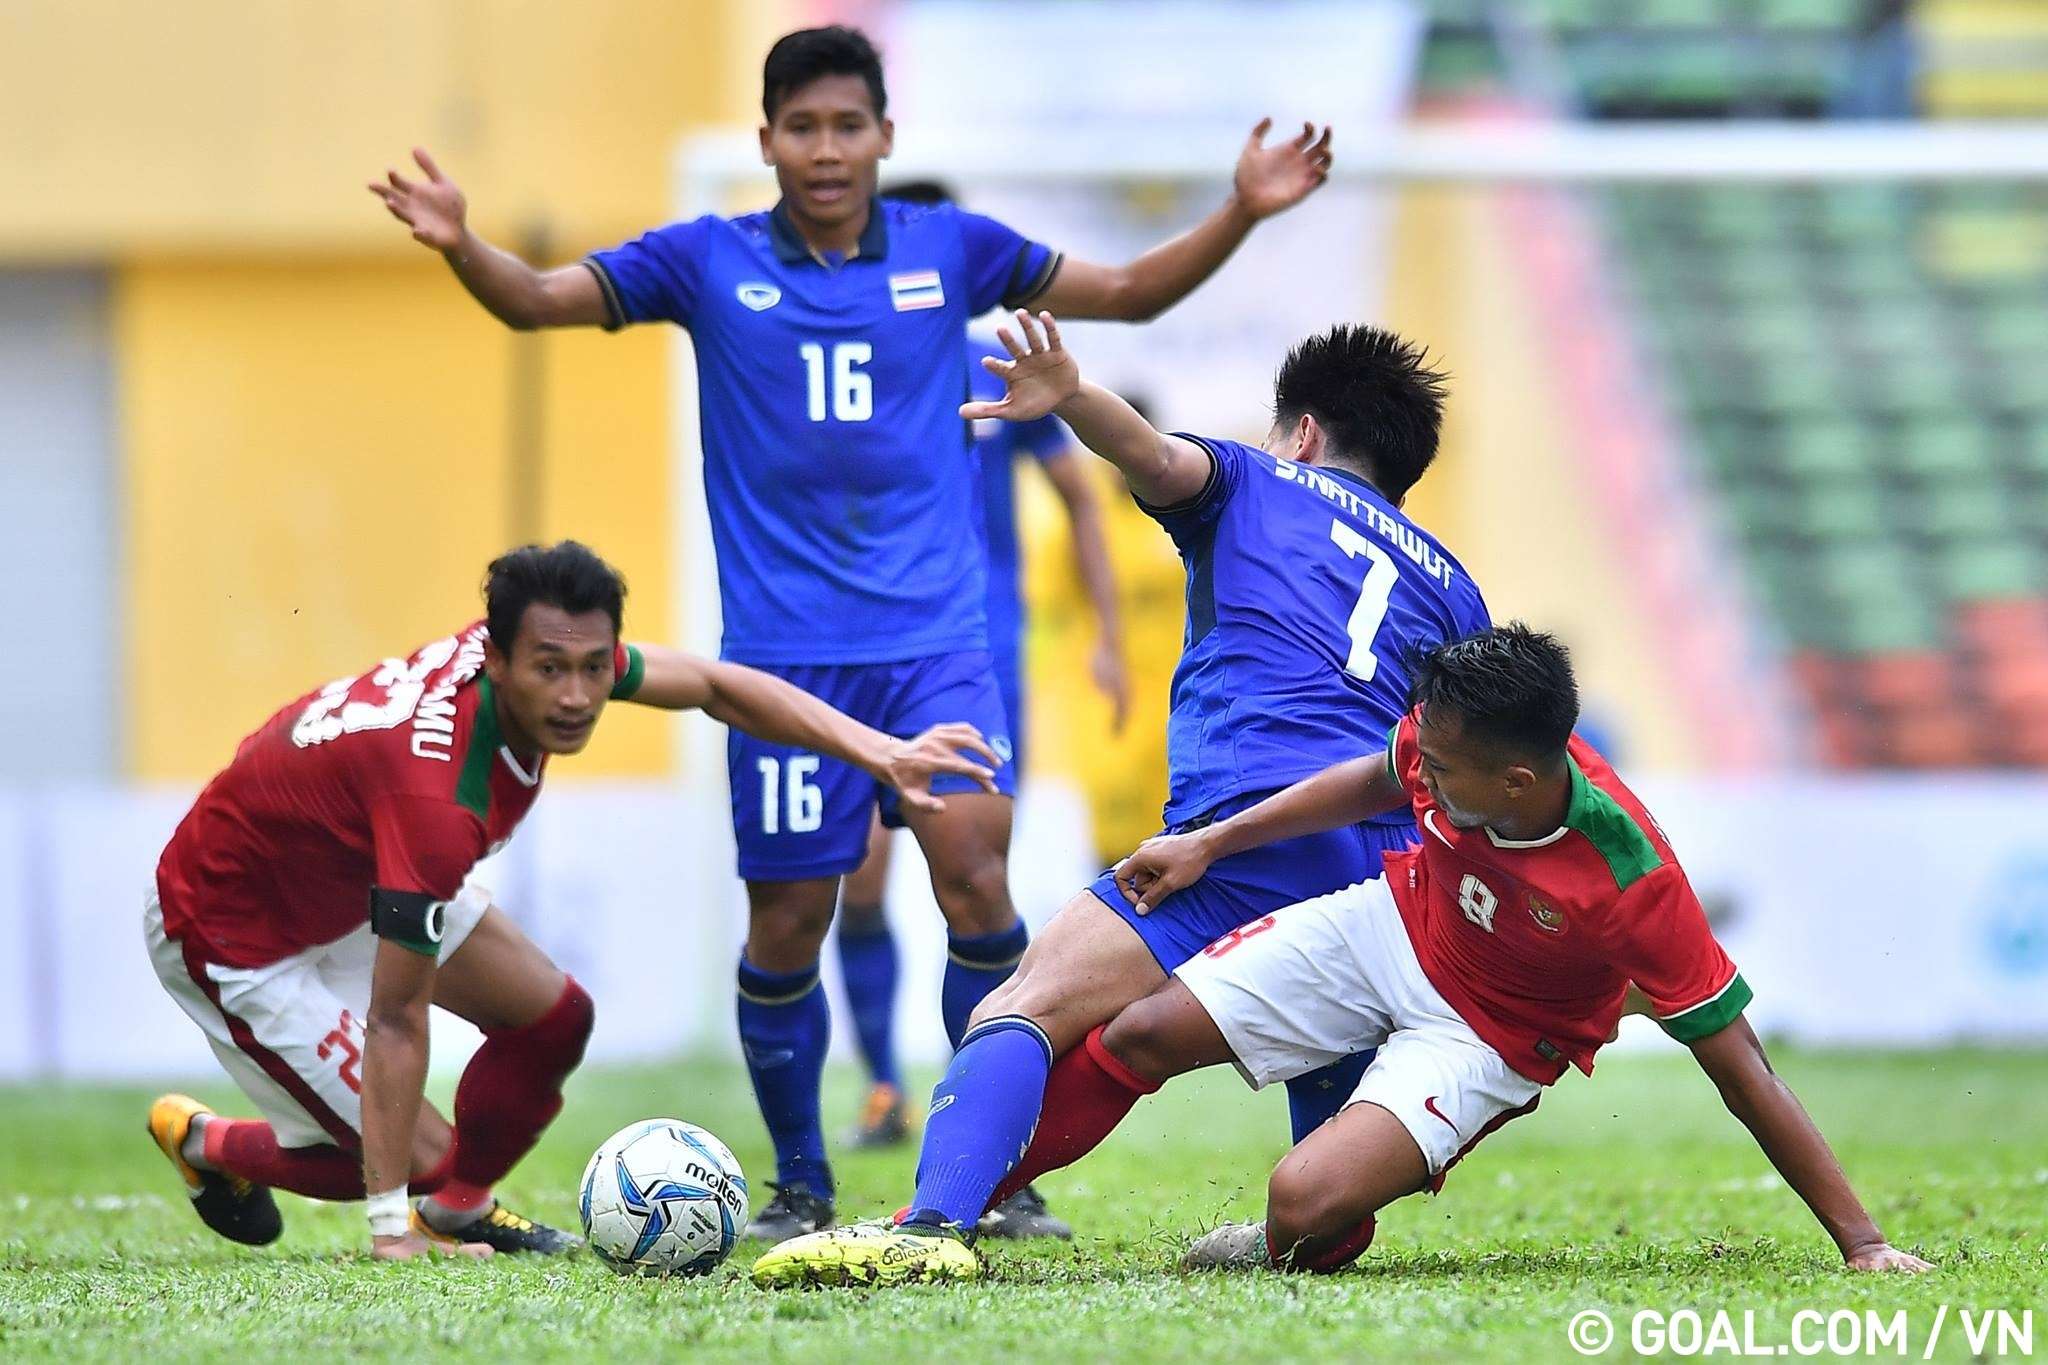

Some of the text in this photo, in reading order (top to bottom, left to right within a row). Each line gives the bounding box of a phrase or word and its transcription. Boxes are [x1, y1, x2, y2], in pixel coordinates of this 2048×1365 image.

[800, 341, 873, 422] 16
[1330, 517, 1400, 683] 7
[757, 755, 824, 834] 16
[685, 1162, 743, 1216] molten
